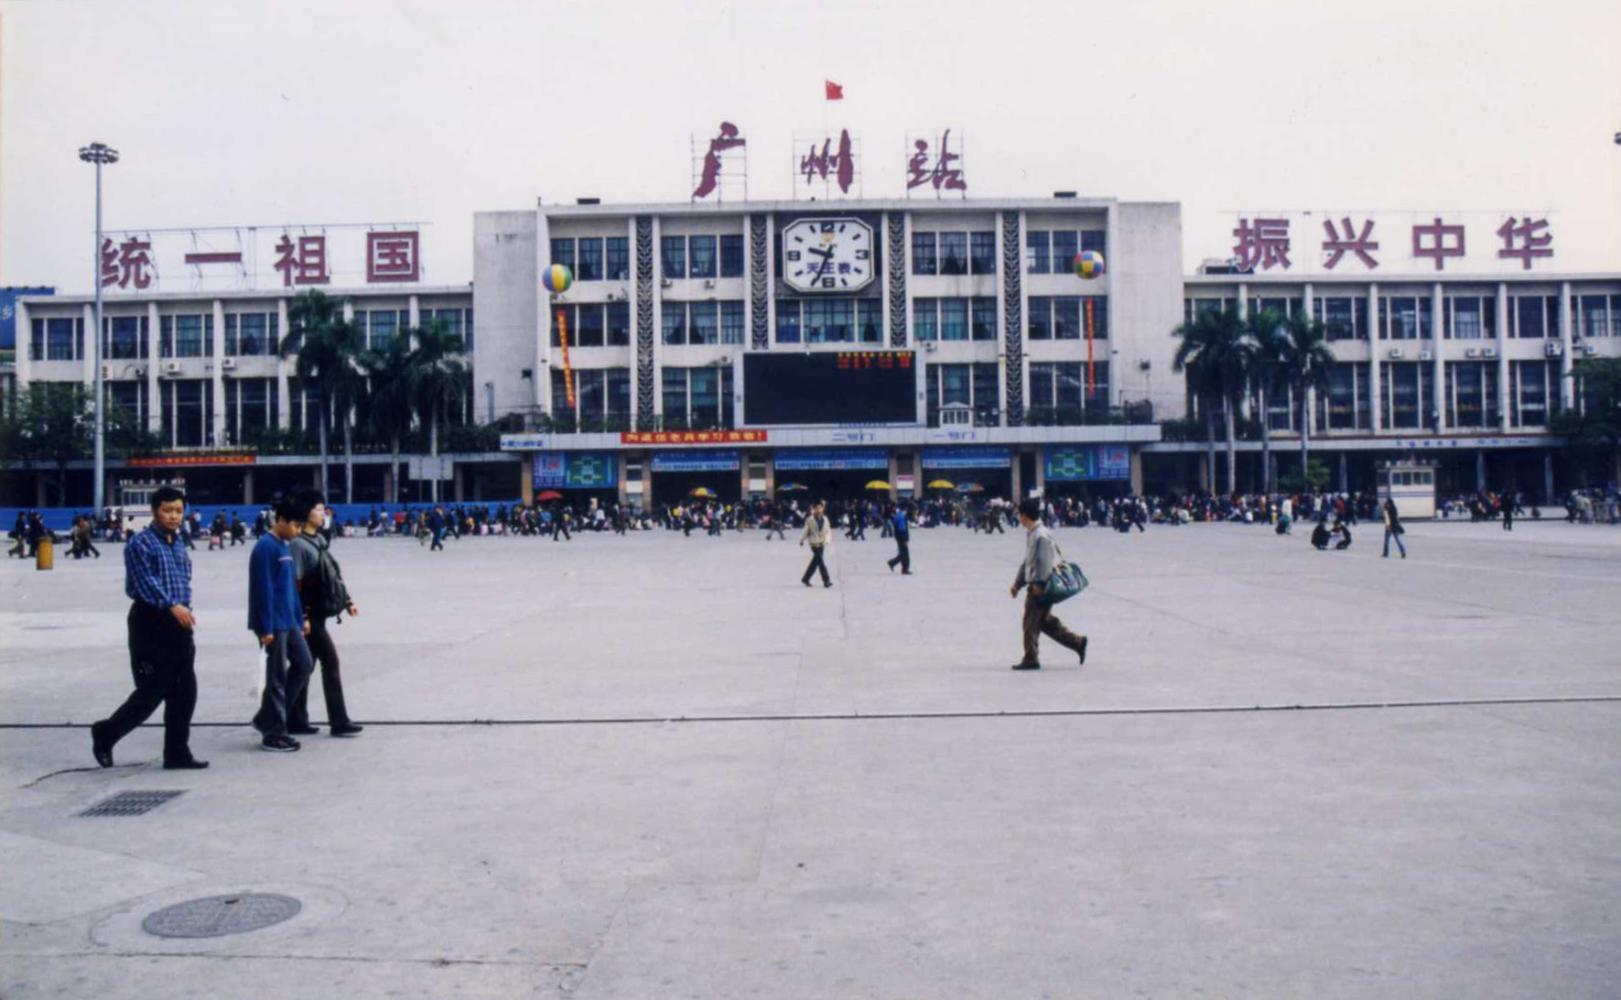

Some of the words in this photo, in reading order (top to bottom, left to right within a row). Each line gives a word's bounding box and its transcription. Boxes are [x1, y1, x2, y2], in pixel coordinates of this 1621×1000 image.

[692, 121, 967, 198] 广州站
[101, 231, 420, 289] 统一祖国
[856, 249, 869, 260] 3
[1232, 217, 1554, 270] 振兴中华
